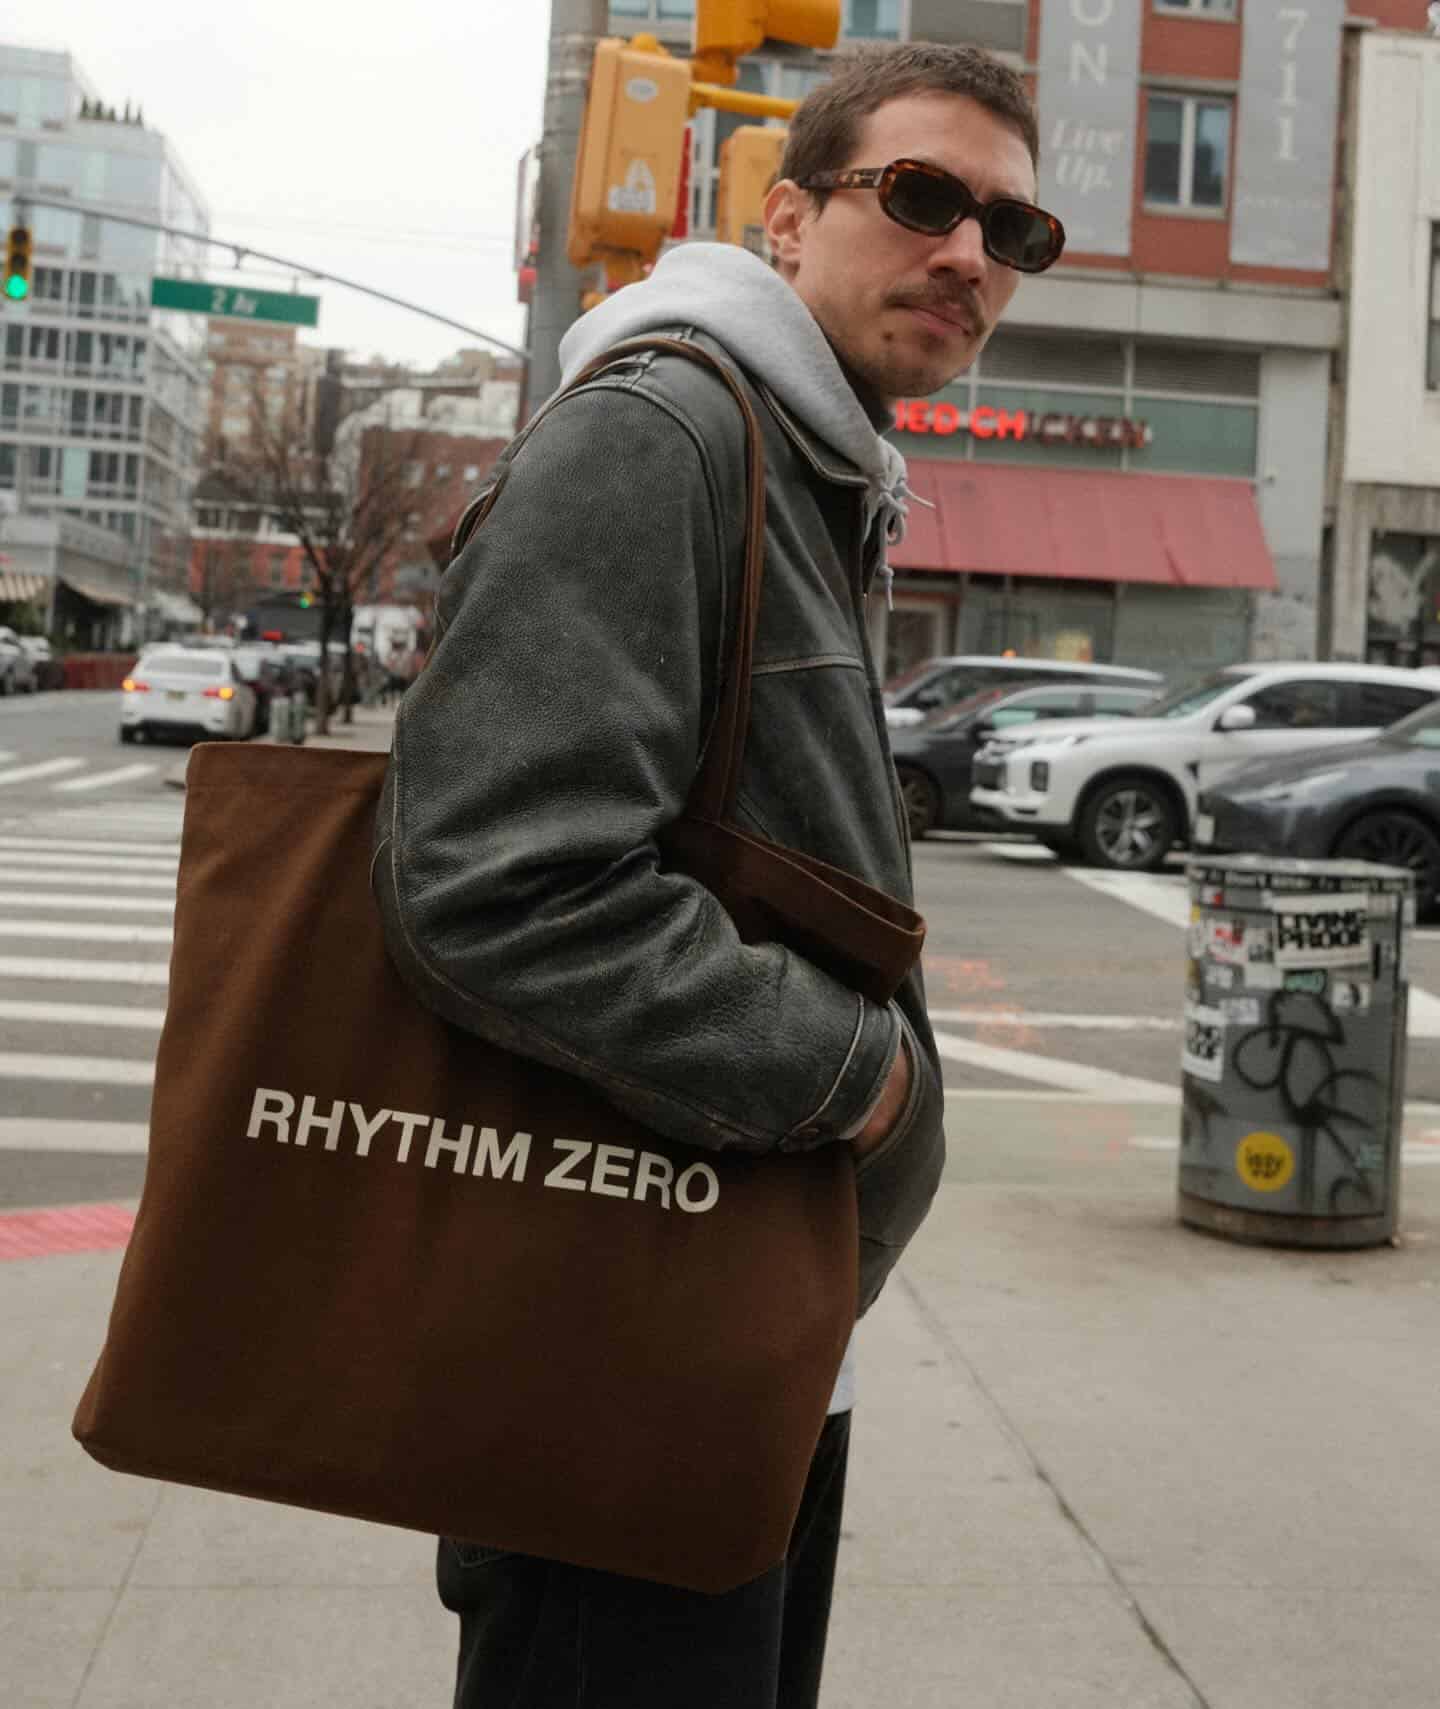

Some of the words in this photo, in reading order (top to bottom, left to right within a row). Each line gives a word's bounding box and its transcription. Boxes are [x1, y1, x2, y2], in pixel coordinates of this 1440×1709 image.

[211, 286, 227, 314] 2
[968, 405, 1149, 448] CHICKEN
[245, 1087, 532, 1183] RHYTHM
[543, 1138, 720, 1214] ZERO
